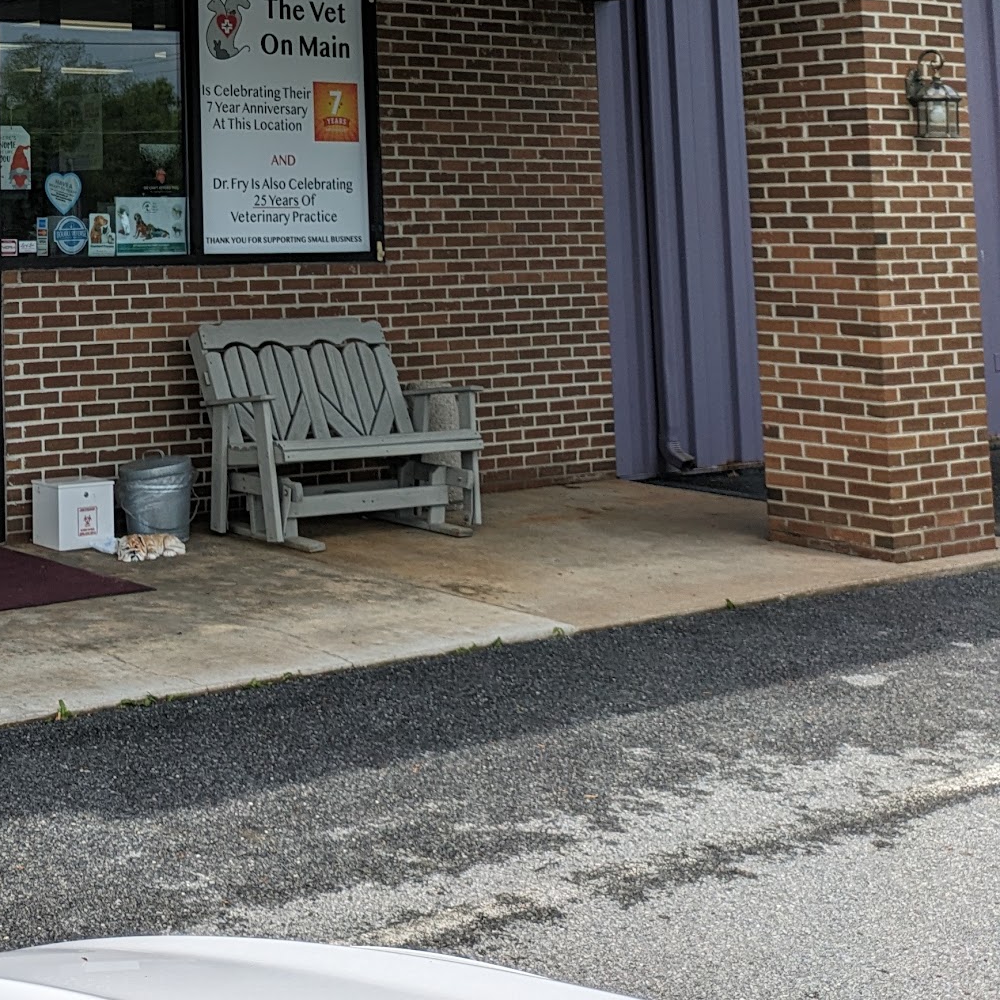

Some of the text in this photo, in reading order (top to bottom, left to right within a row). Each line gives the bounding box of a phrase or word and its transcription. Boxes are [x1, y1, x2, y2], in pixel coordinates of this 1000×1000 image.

[309, 1, 345, 23] Vet
[261, 34, 350, 58] On Main
[202, 84, 311, 101] Is Celebrating Their
[207, 101, 307, 118] 7 Year Anniversary
[329, 90, 342, 115] 7
[213, 117, 302, 131] At This Location
[327, 117, 347, 125] YEARS
[271, 155, 295, 166] AND
[214, 177, 353, 193] Dr. Fry Is Also Celebrating
[254, 193, 316, 206] 25 Years Of
[231, 211, 337, 226] Veterinary Practice
